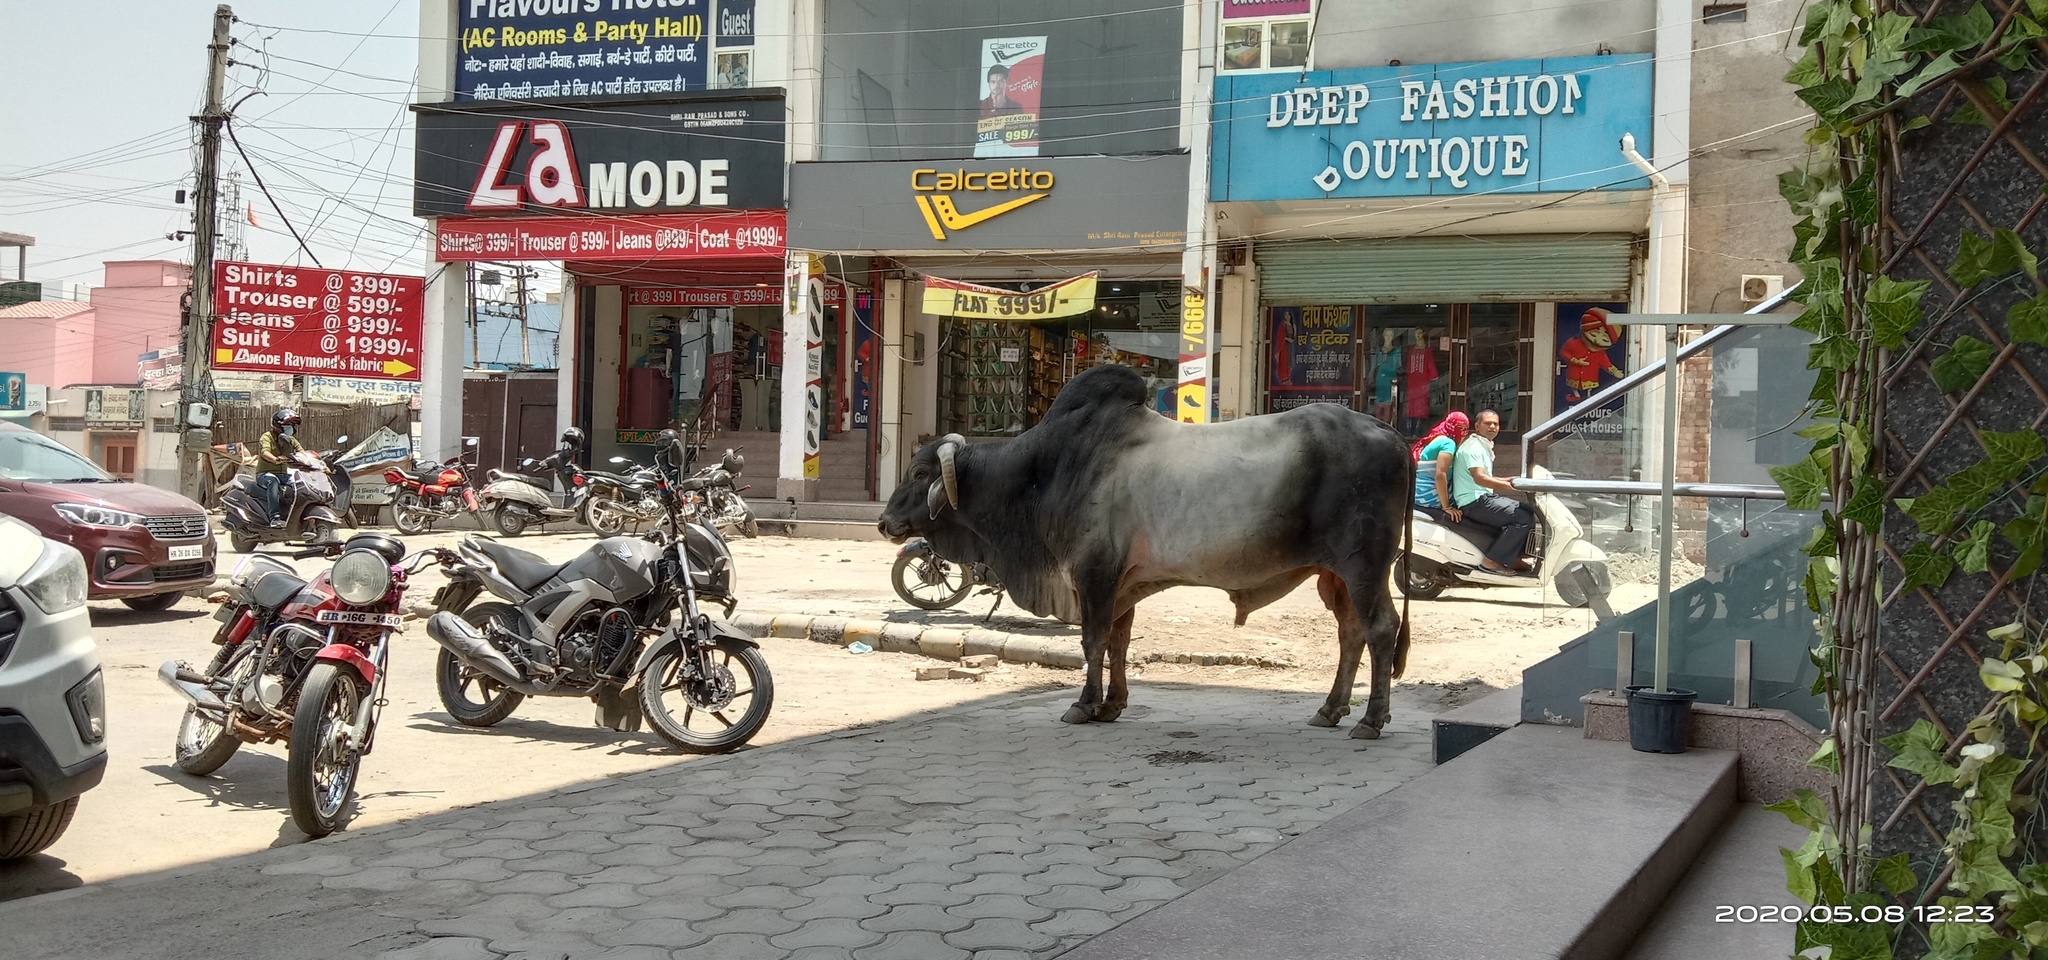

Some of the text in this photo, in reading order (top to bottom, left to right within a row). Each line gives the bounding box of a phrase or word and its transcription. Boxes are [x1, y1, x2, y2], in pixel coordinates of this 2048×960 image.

[722, 7, 750, 35] Guest
[462, 14, 703, 53] (AC Rooms & Party Hall)
[989, 41, 1038, 50] Calcetto
[488, 54, 509, 72] हमारे
[561, 80, 571, 96] के
[572, 78, 589, 96] लिए
[590, 80, 604, 95] AC
[697, 111, 717, 120] PRASAD
[738, 110, 749, 118] CO.
[1266, 84, 1370, 128] DEEP
[979, 129, 1039, 142] SALE 999/-
[589, 159, 729, 208] MODE
[911, 167, 1055, 191] Calcetto
[486, 232, 515, 252] 399/-
[520, 231, 610, 253] Trouser @ 599/-
[616, 230, 652, 250] Jeans
[700, 228, 729, 248] Coat
[225, 265, 406, 296] Shirts @ 399/-
[223, 286, 403, 316] Trouser @ 599/-
[642, 290, 650, 303] @
[652, 290, 672, 303] 399
[678, 290, 728, 303] Trousers
[732, 290, 741, 303] @
[743, 289, 771, 302] 599/-
[954, 292, 990, 313] FLAT
[222, 309, 403, 336] Jeans @ 999/-
[222, 327, 414, 357] Suit @ 1999/-
[284, 351, 347, 370] Raymond's
[349, 356, 383, 372] fabric
[346, 380, 377, 393] जूस
[1590, 421, 1623, 434] House
[320, 612, 339, 621] HR
